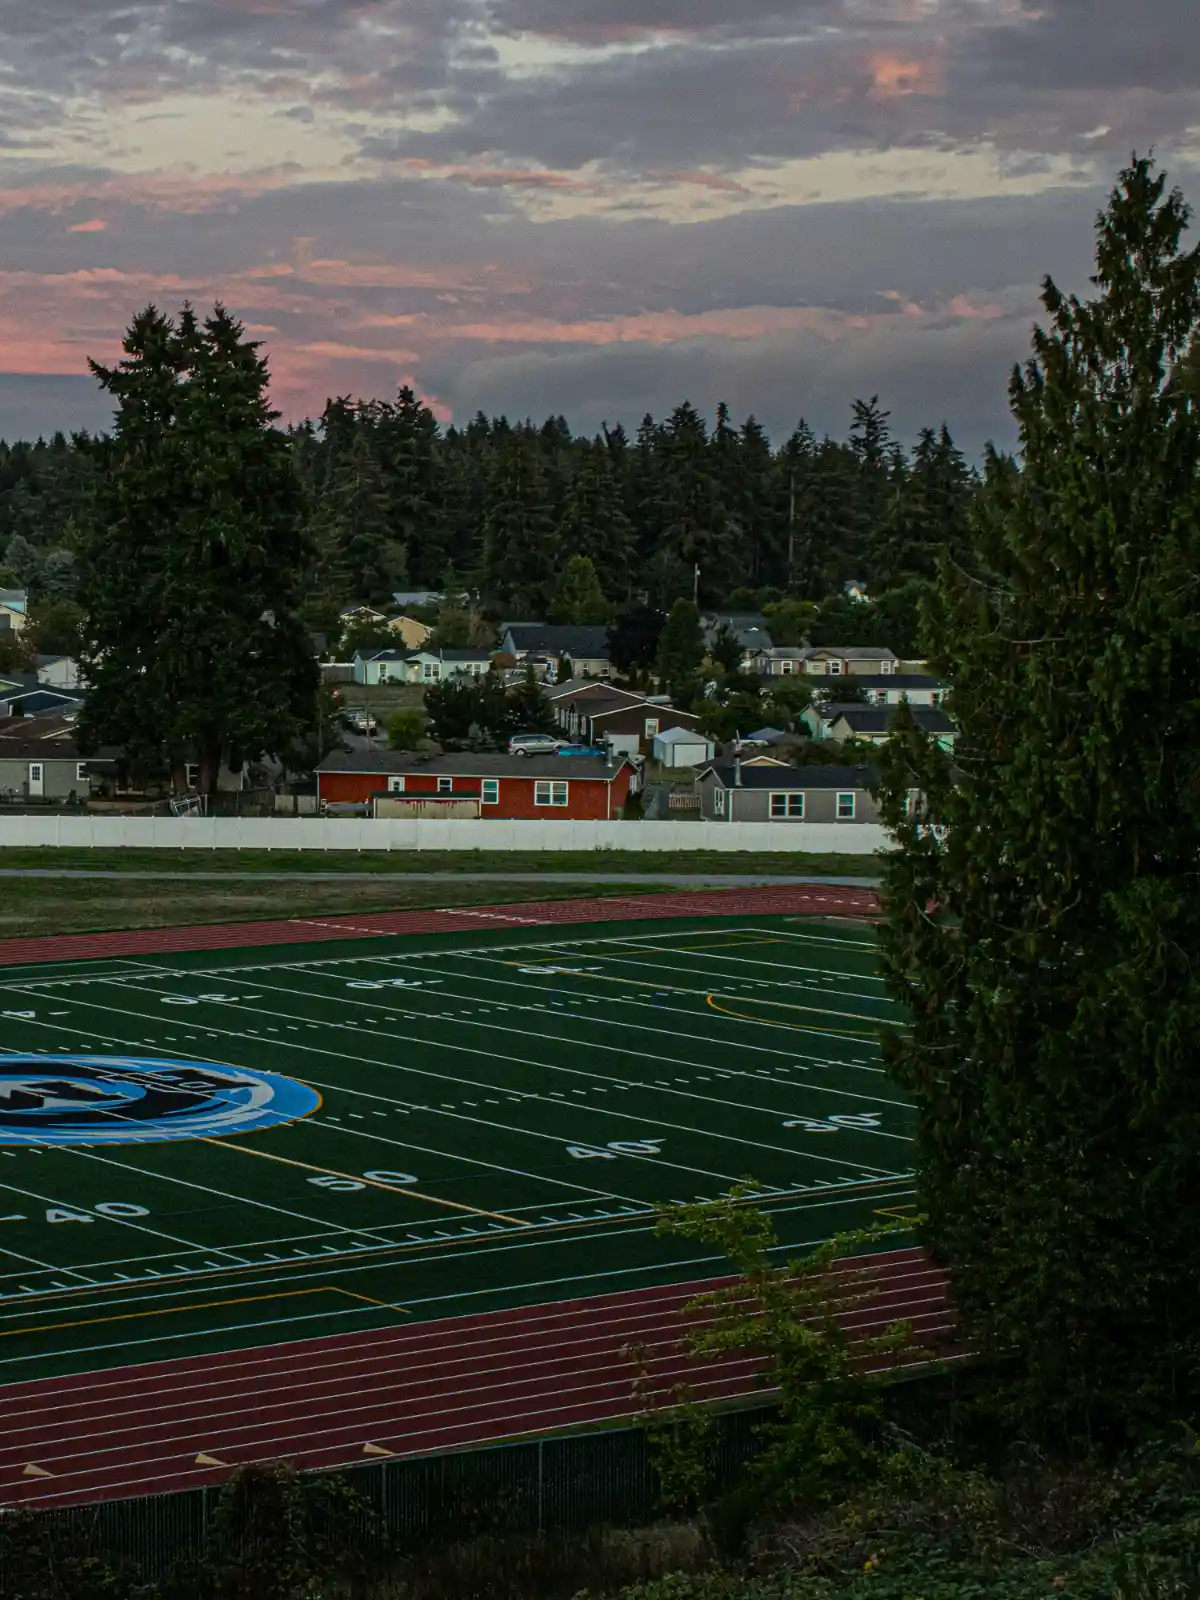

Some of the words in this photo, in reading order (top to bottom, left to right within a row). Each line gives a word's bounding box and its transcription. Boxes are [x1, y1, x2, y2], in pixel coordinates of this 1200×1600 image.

[346, 978, 424, 989] 20
[159, 993, 240, 1005] 30
[781, 1112, 882, 1134] 30
[563, 1138, 661, 1161] 40
[305, 1170, 419, 1192] 50
[44, 1201, 152, 1225] 40
